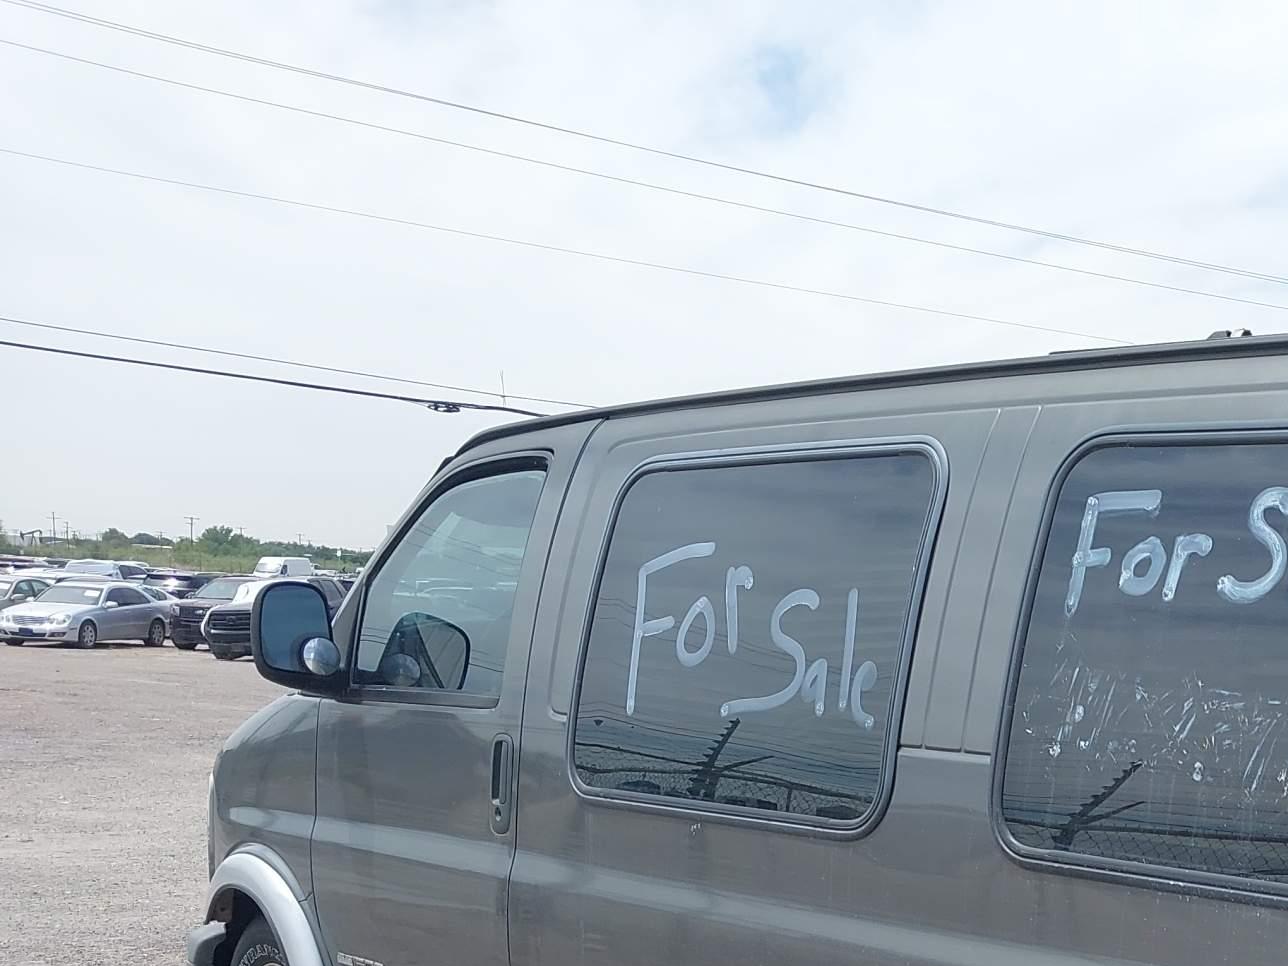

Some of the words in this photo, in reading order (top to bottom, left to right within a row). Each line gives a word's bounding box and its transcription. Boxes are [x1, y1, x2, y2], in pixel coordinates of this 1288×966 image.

[1064, 488, 1212, 616] For
[626, 541, 754, 715] For
[719, 588, 878, 729] Sale
